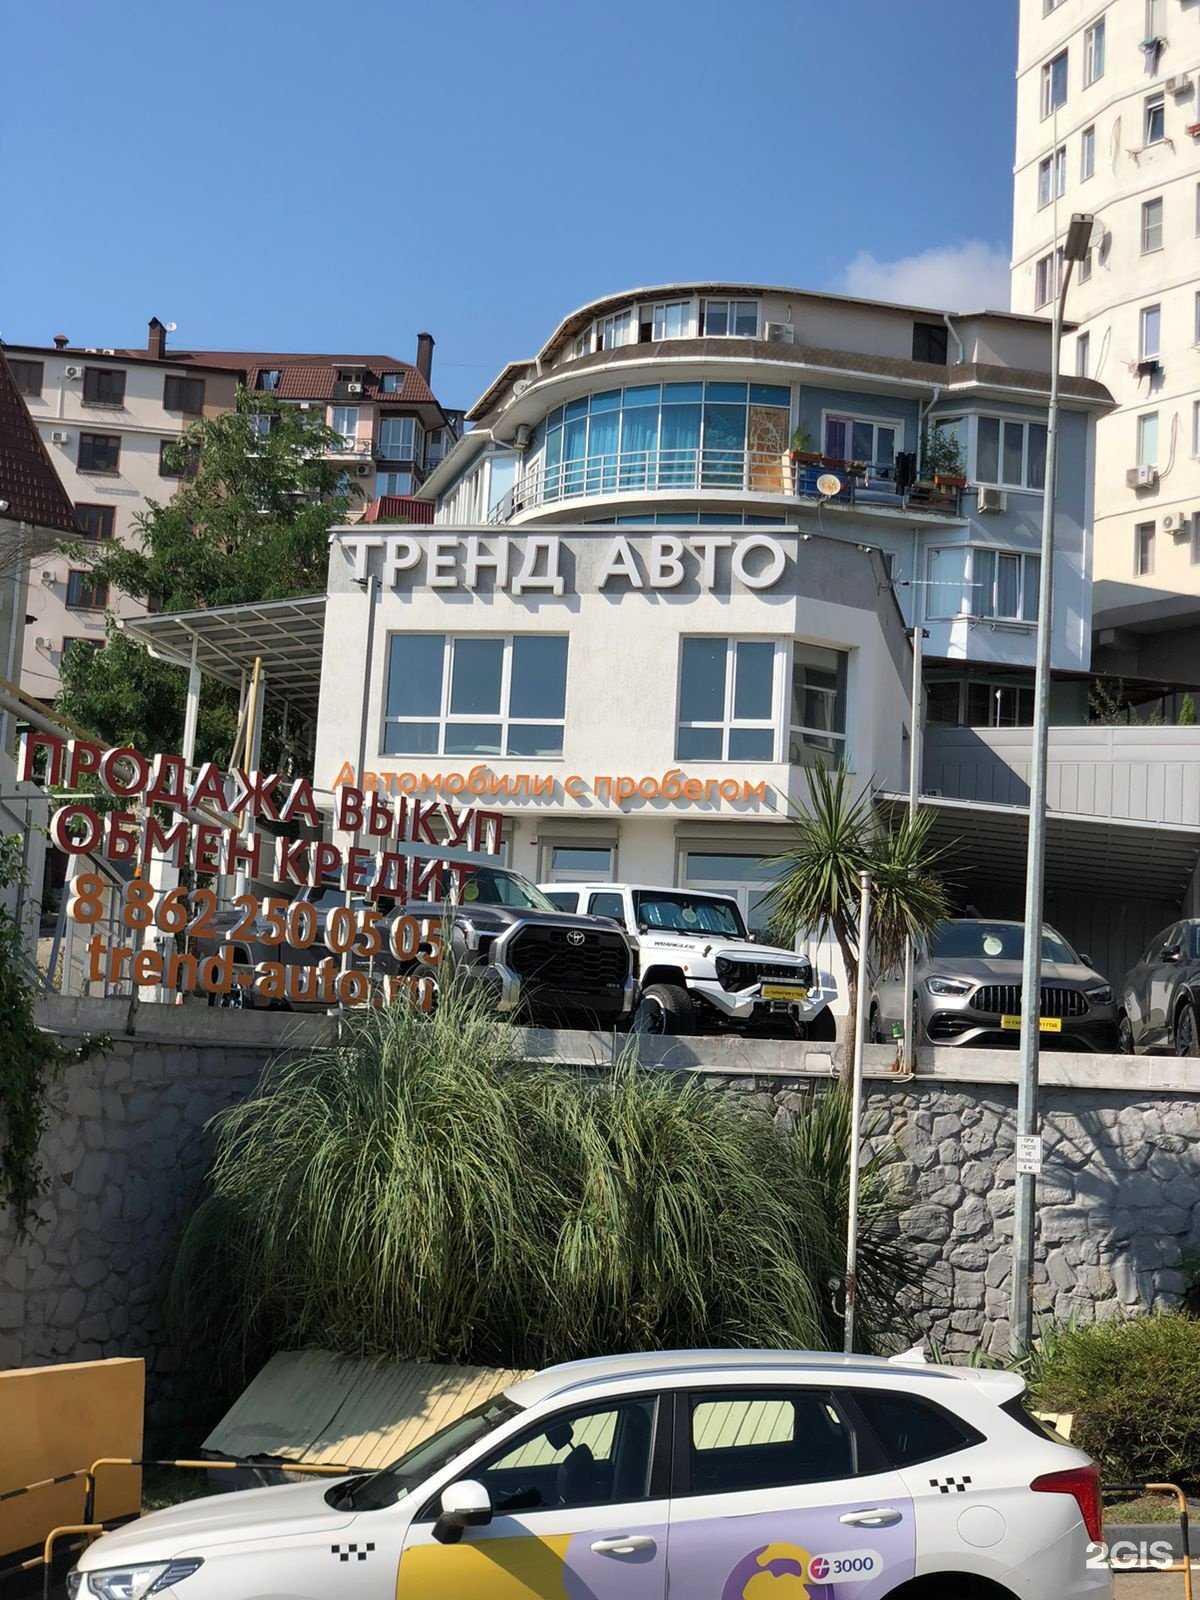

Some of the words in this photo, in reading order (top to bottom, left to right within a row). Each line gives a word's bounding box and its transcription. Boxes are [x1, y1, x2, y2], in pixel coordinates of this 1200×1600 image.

[341, 535, 565, 596] ТРЕНД
[598, 534, 786, 589] АВТО
[17, 731, 319, 828] ПРОДАЖА
[335, 785, 503, 855] ВЫКУП
[332, 760, 554, 796] Автомобили
[564, 775, 586, 799] с
[594, 768, 767, 806] пробегом
[51, 804, 262, 879] ОБМЕН
[273, 836, 480, 906] КРЕДИТ
[67, 872, 104, 924] 8
[121, 879, 218, 938] 862
[226, 895, 317, 949] 250
[324, 907, 382, 957] 05
[390, 915, 444, 966] 05
[86, 933, 434, 1014] trend-auto.ru
[833, 1556, 874, 1574] 3000
